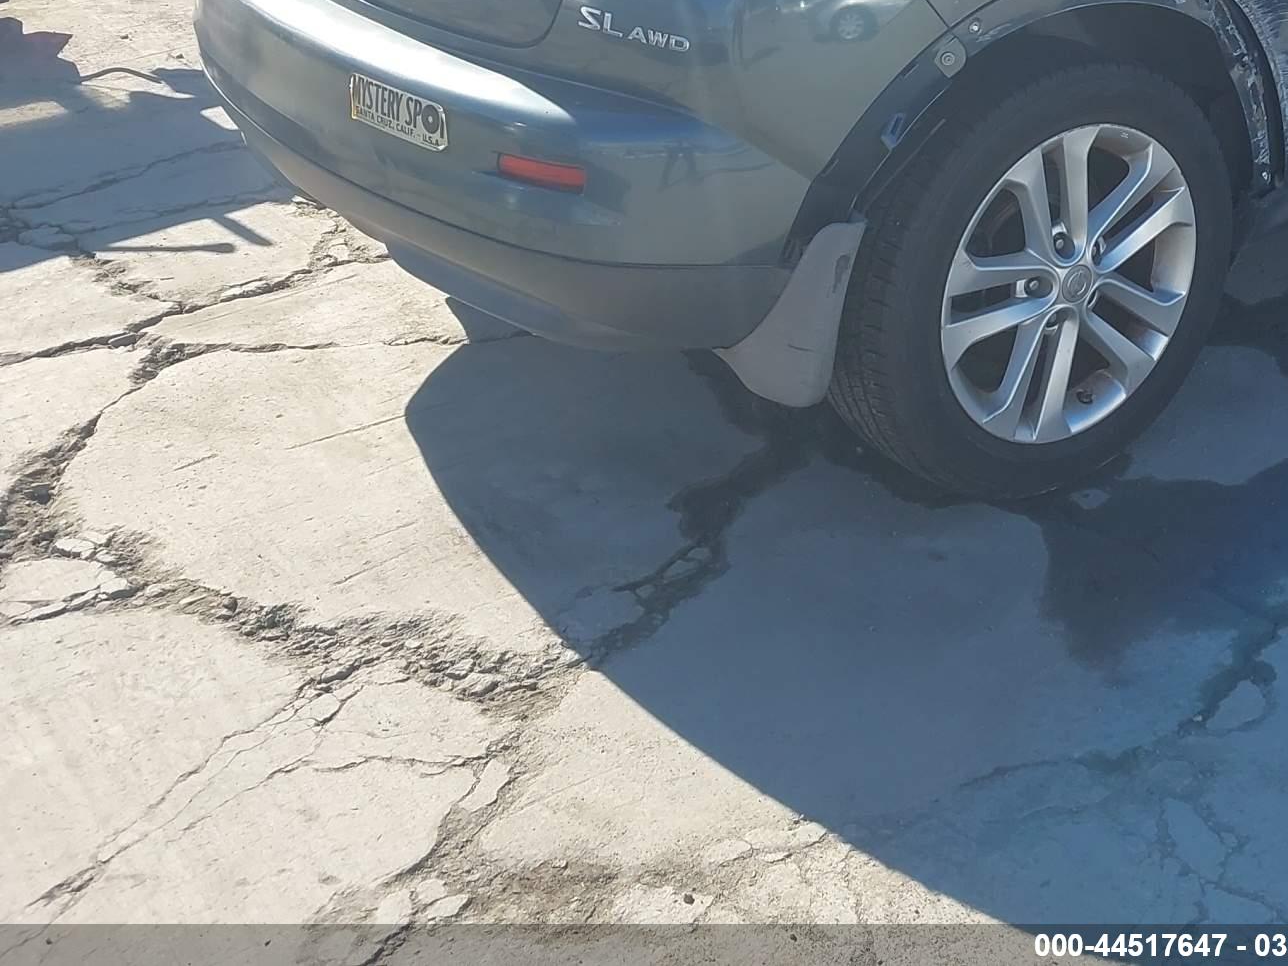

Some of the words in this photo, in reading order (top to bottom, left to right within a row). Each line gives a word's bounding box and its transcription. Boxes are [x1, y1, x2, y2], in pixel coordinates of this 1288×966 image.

[578, 5, 623, 38] SL
[627, 26, 690, 52] AWD
[352, 73, 404, 122] MYSTERY
[355, 105, 374, 120] SANTA
